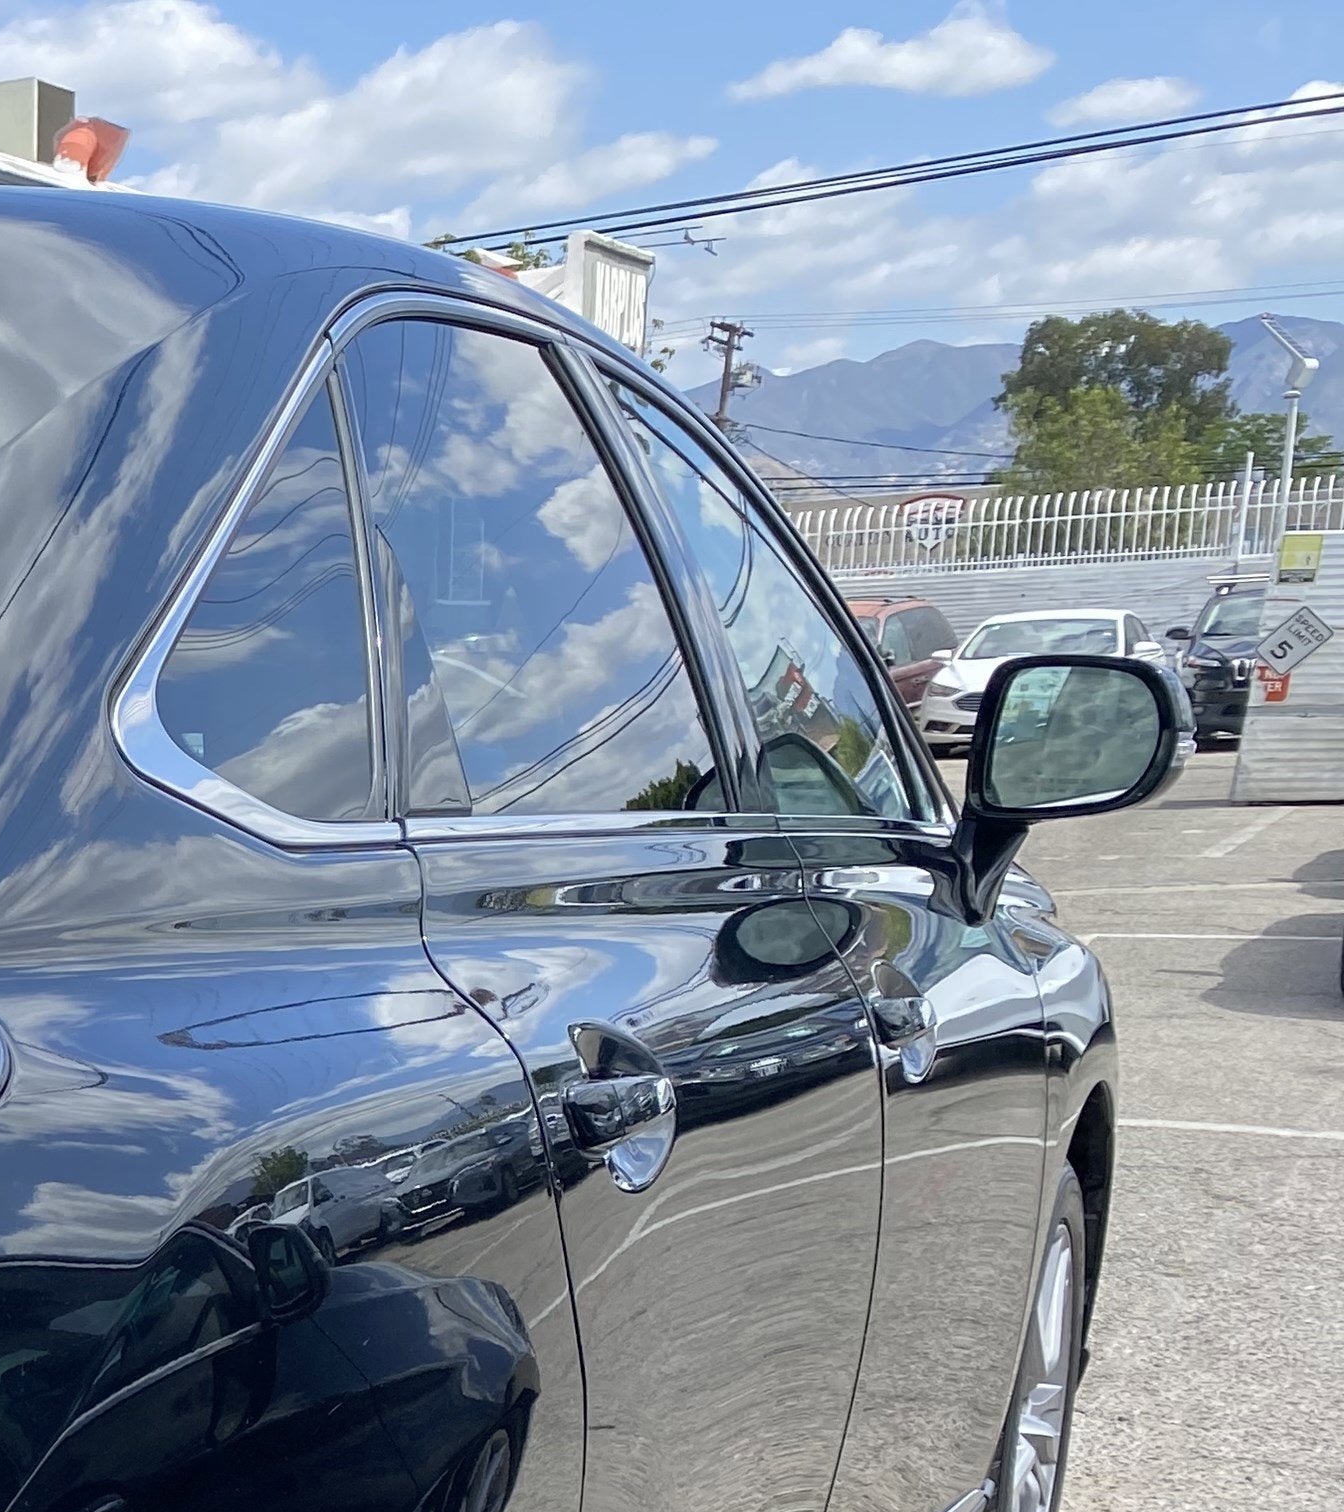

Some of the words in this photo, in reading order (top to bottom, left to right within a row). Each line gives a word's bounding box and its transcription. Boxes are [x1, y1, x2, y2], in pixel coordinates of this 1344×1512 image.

[1287, 624, 1313, 646] LIMIT
[1295, 614, 1325, 642] SPEED
[1269, 640, 1294, 659] 5
